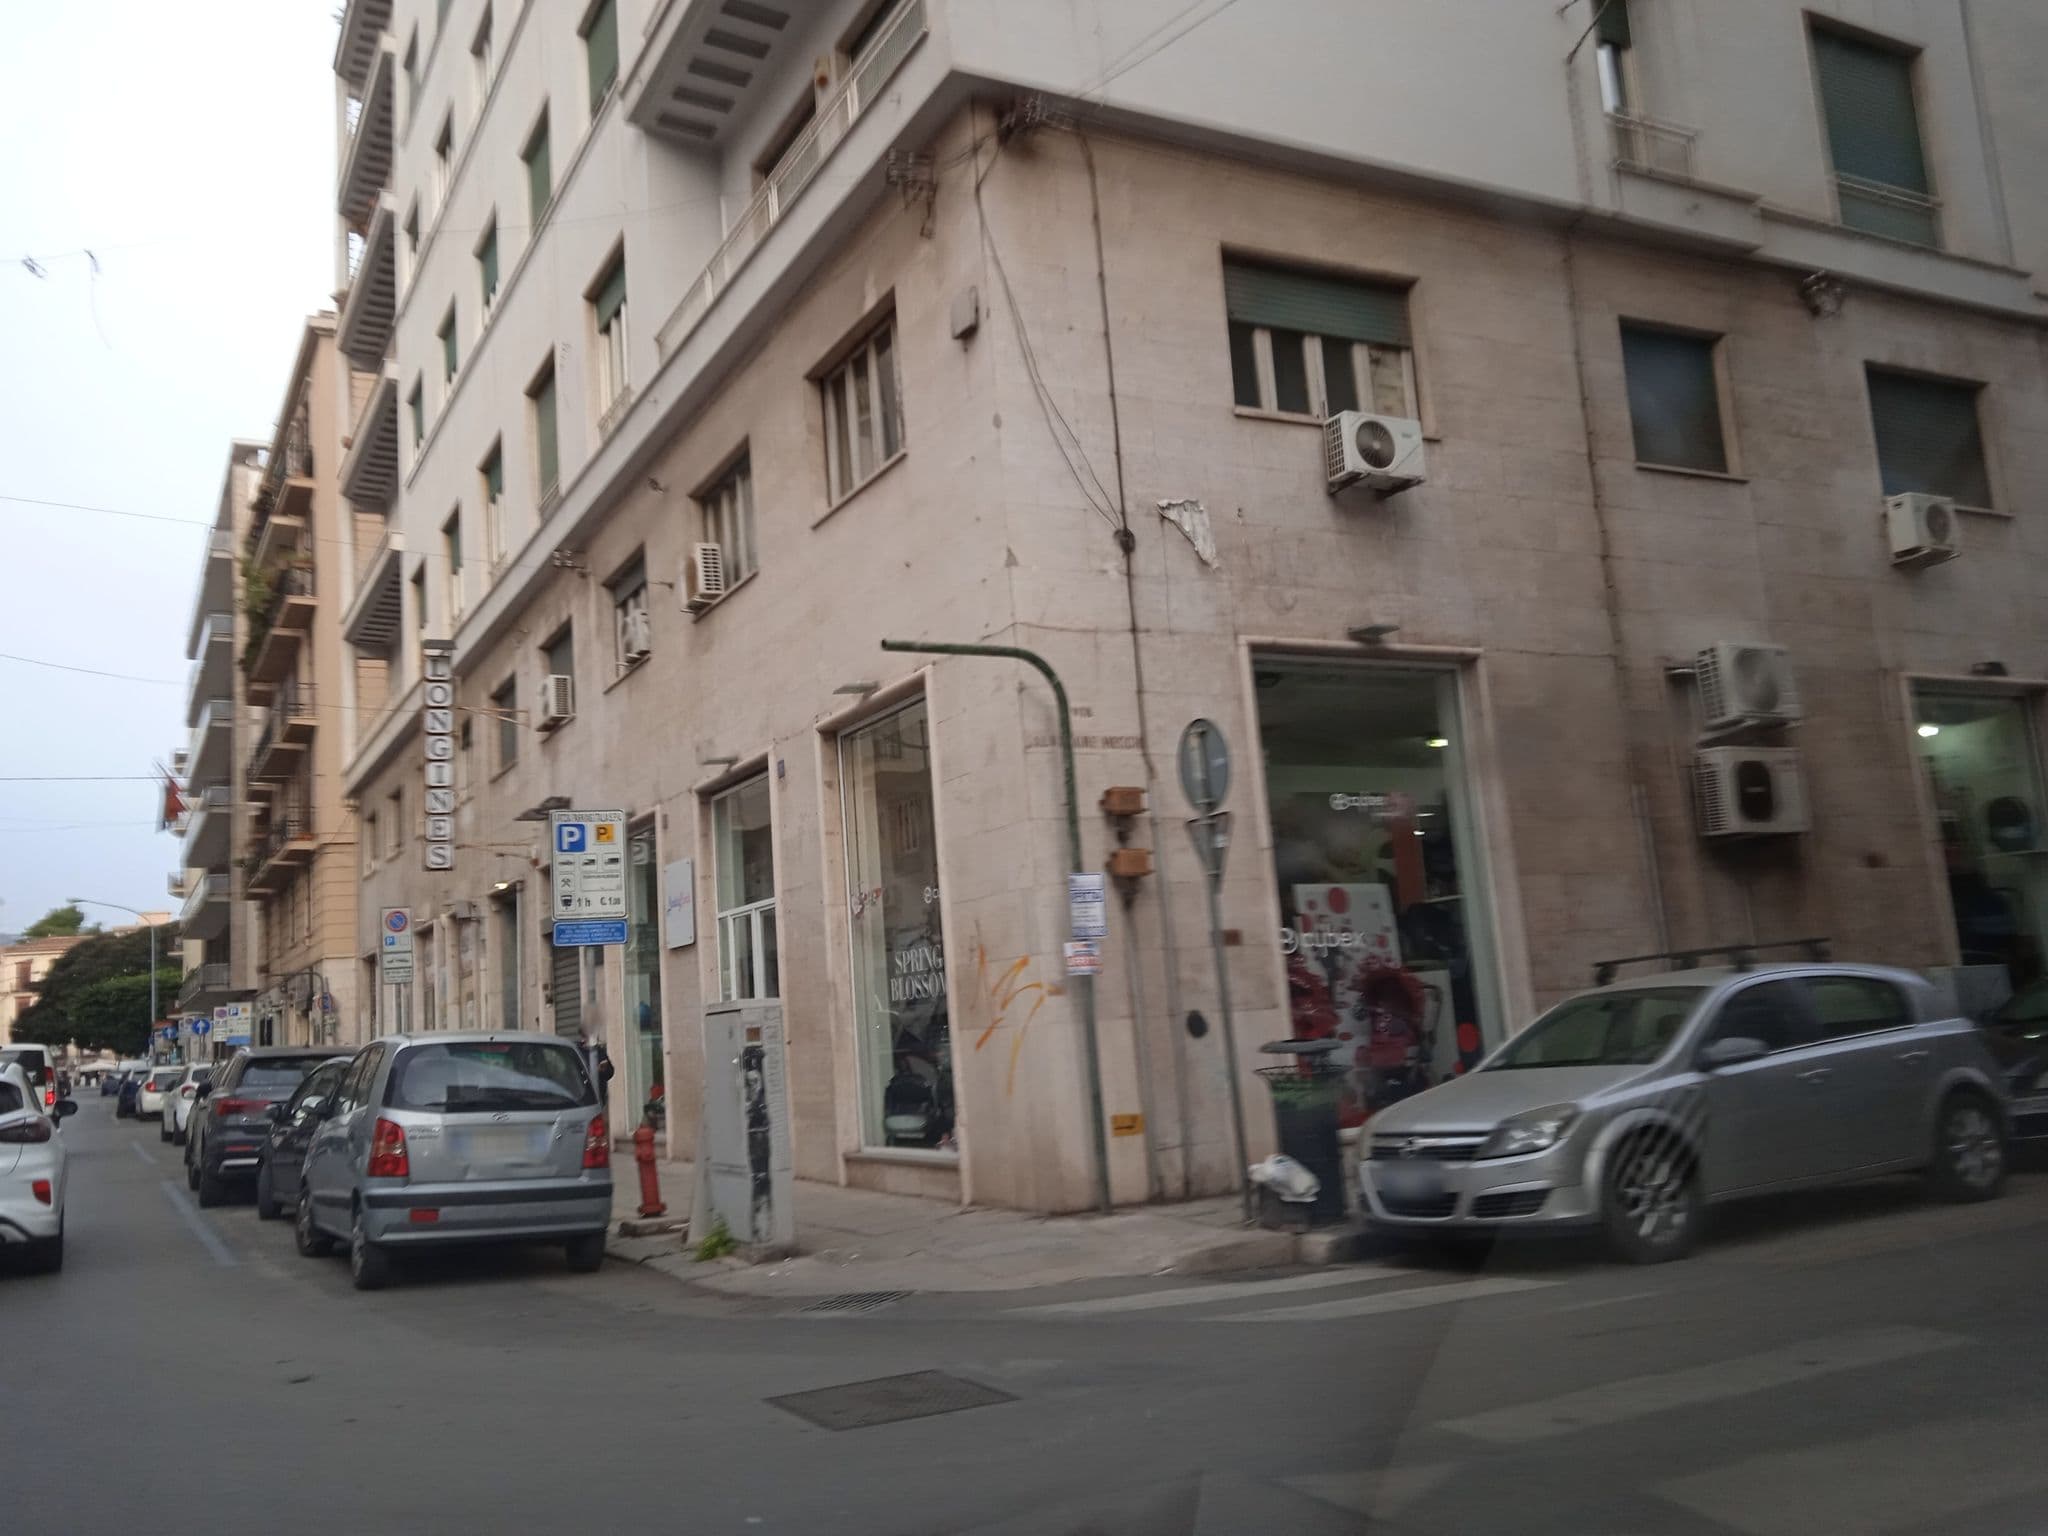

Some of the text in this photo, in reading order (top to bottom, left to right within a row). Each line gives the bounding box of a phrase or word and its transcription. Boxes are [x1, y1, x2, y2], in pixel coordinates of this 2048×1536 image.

[430, 657, 449, 866] LONGINES
[561, 826, 581, 850] P
[895, 944, 943, 974] SPRING
